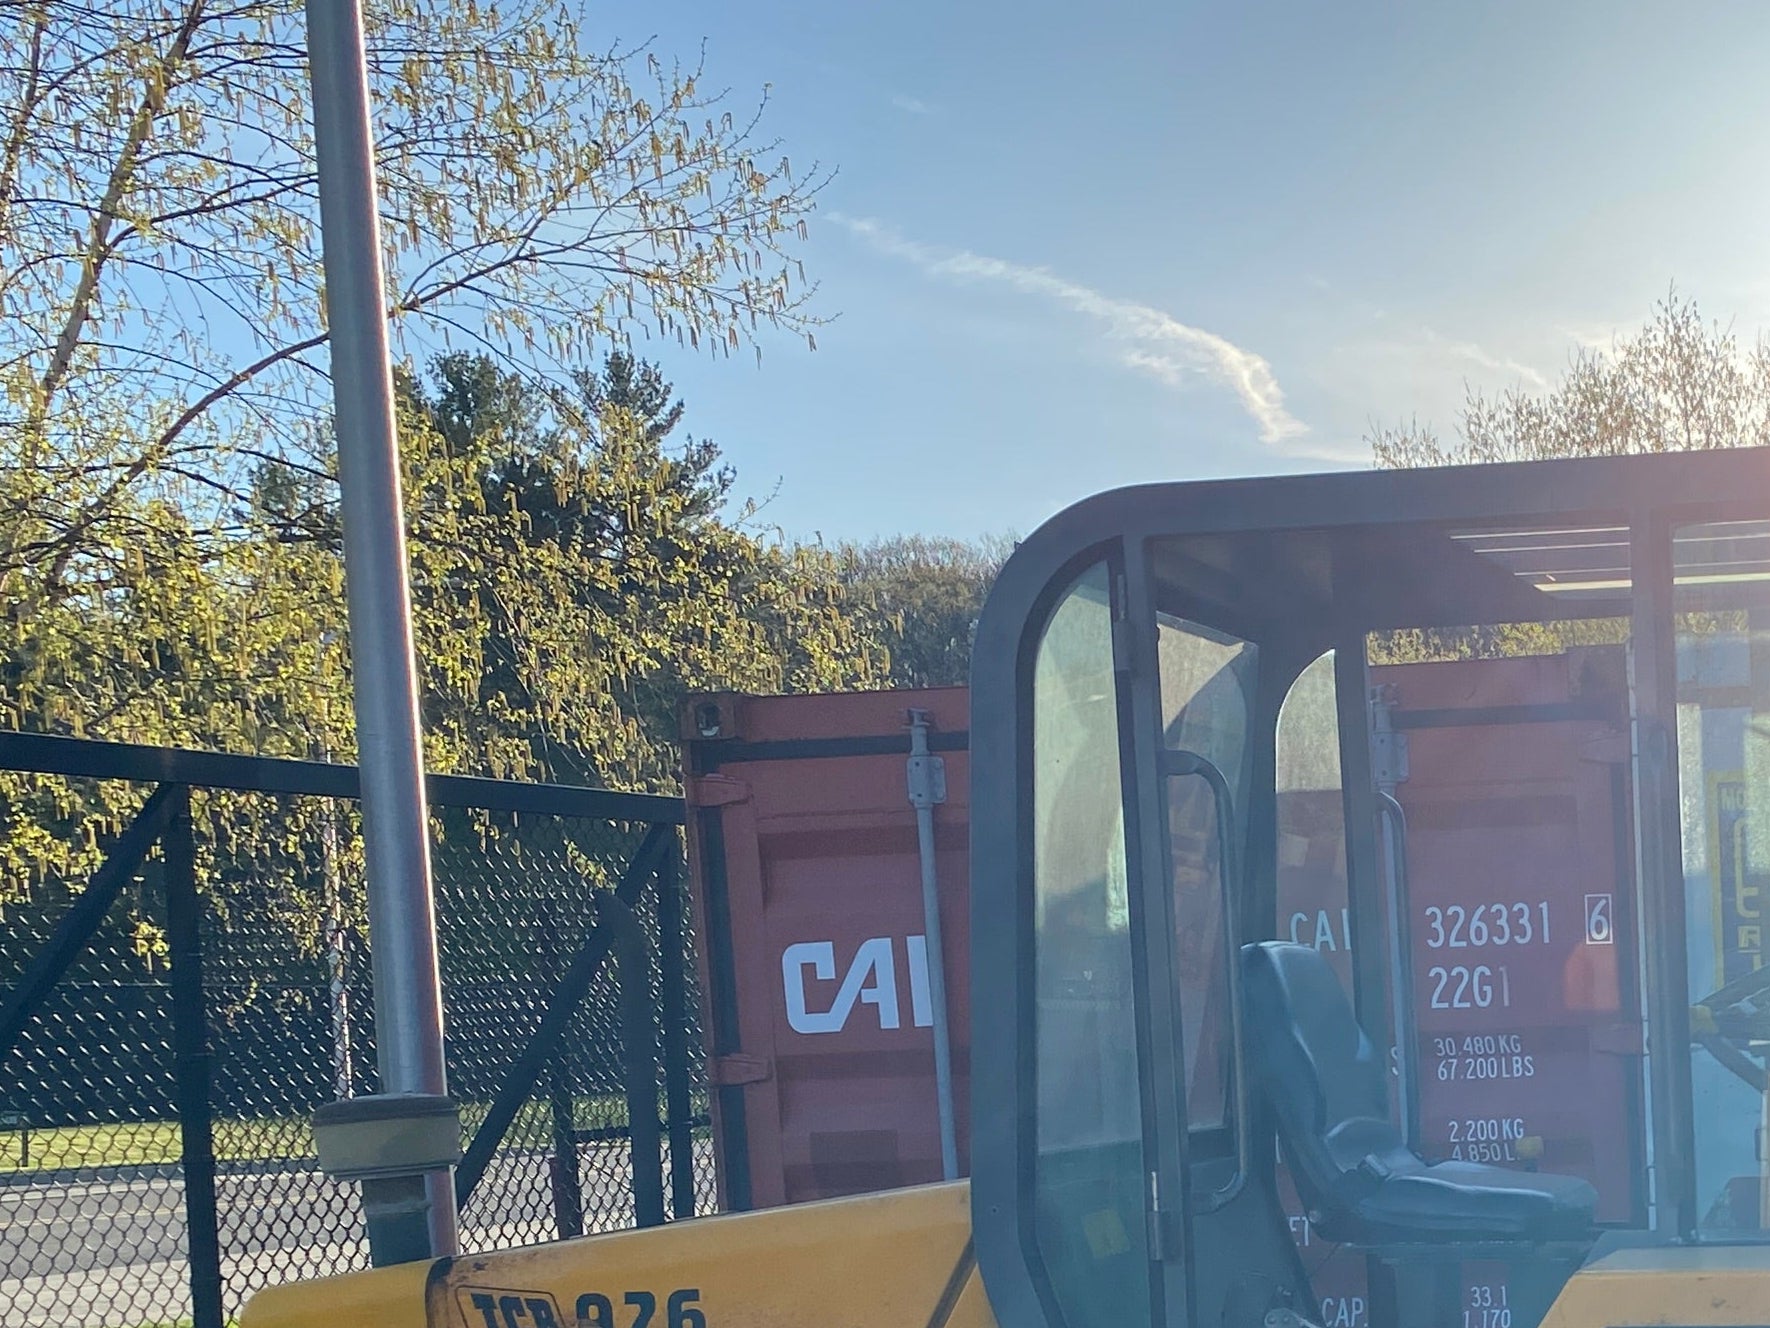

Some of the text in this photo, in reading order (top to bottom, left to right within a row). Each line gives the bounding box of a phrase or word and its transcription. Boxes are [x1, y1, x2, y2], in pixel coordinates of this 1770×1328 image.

[1425, 901, 1550, 948] 326331
[1590, 899, 1609, 941] 6
[782, 935, 934, 1034] CAI
[1428, 965, 1510, 1009] 22G1
[1498, 1034, 1521, 1054] KG
[1501, 1056, 1534, 1078] LBS
[1501, 1118, 1524, 1140] KG
[1321, 1297, 1369, 1328] CAP.
